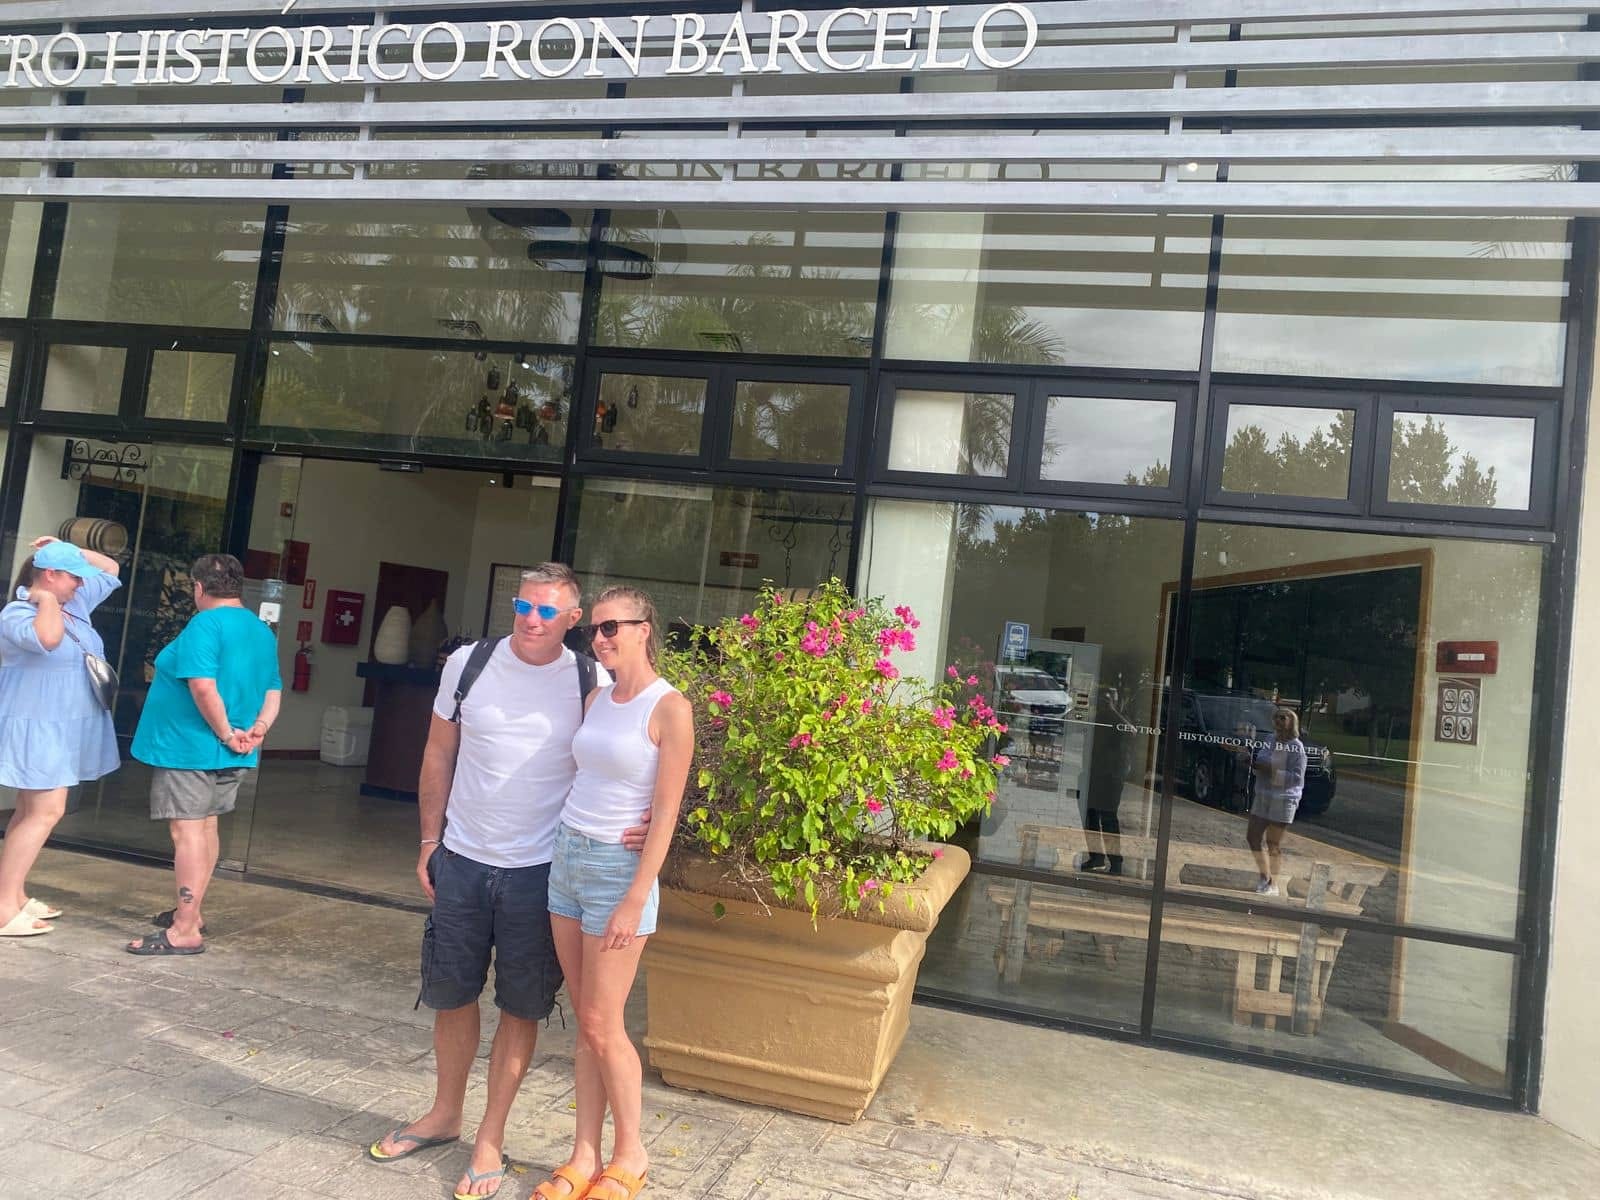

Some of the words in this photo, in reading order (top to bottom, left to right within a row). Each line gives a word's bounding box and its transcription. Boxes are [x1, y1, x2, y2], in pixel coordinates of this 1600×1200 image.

[0, 31, 87, 89] RO
[100, 0, 467, 87] HISTÓRICO
[485, 14, 651, 80] RON
[1116, 723, 1161, 736] CENTRO
[1179, 731, 1241, 746] HISTÓRICO
[1245, 738, 1272, 750] RON
